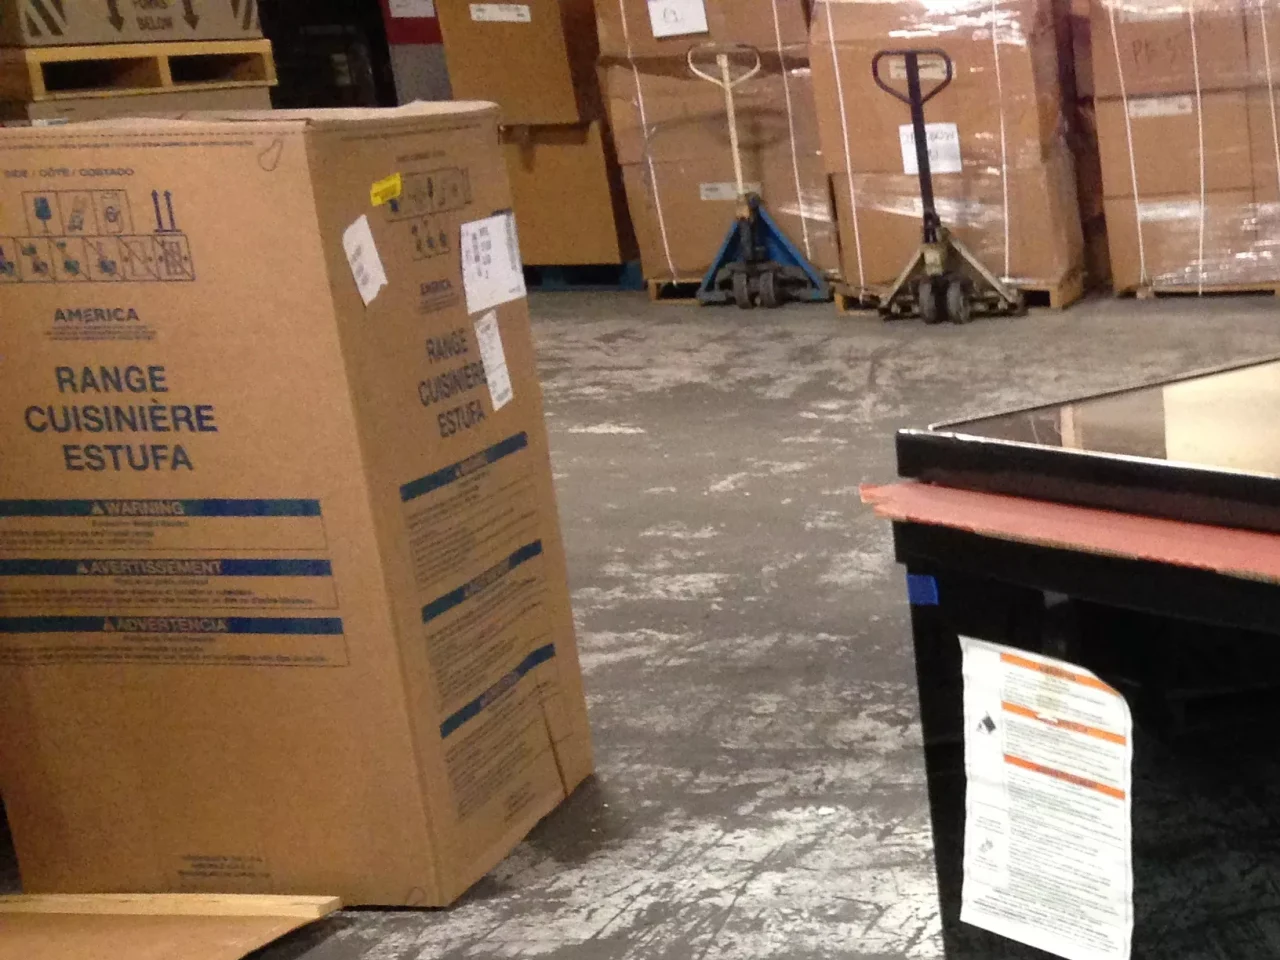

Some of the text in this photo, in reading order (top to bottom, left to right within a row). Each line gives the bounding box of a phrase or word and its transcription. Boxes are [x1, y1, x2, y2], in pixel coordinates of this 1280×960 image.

[54, 308, 140, 322] AMERICA
[425, 327, 469, 364] RANGE
[54, 365, 169, 393] RANGE
[24, 398, 219, 433] CUISINIÈRE
[436, 399, 487, 438] ESTUFA
[62, 444, 194, 472] ESTUFA
[104, 501, 185, 515] WARNING
[91, 560, 223, 575] AVERTISSEMENT
[117, 618, 229, 632] ADVERTENCIA
